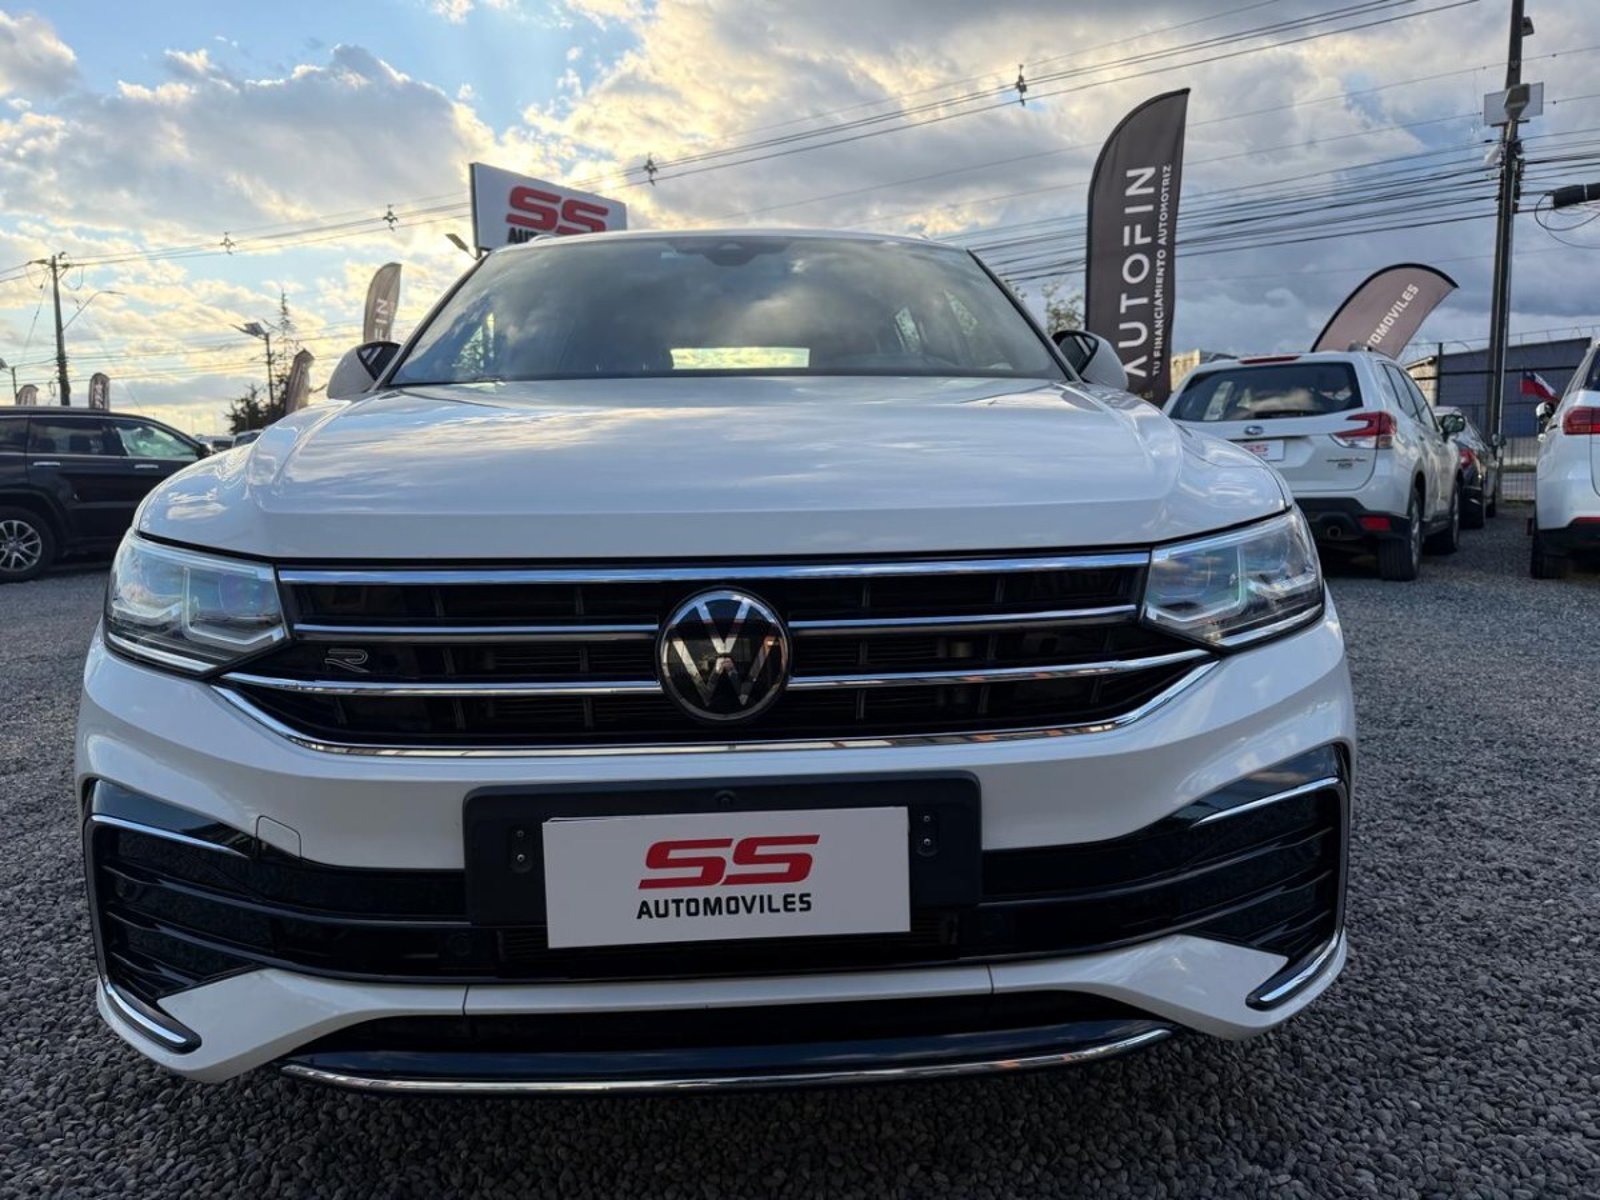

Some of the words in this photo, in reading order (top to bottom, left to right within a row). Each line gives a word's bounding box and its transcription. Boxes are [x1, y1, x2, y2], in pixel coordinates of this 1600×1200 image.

[505, 185, 610, 235] SS
[1157, 163, 1172, 246] AUTOMOTRIZ
[1117, 165, 1157, 378] AUTOFIN
[1152, 249, 1167, 358] FINANCIAMIENTO
[1152, 360, 1161, 376] TU
[637, 834, 821, 890] SS
[635, 892, 812, 920] AUTOMOVILES
